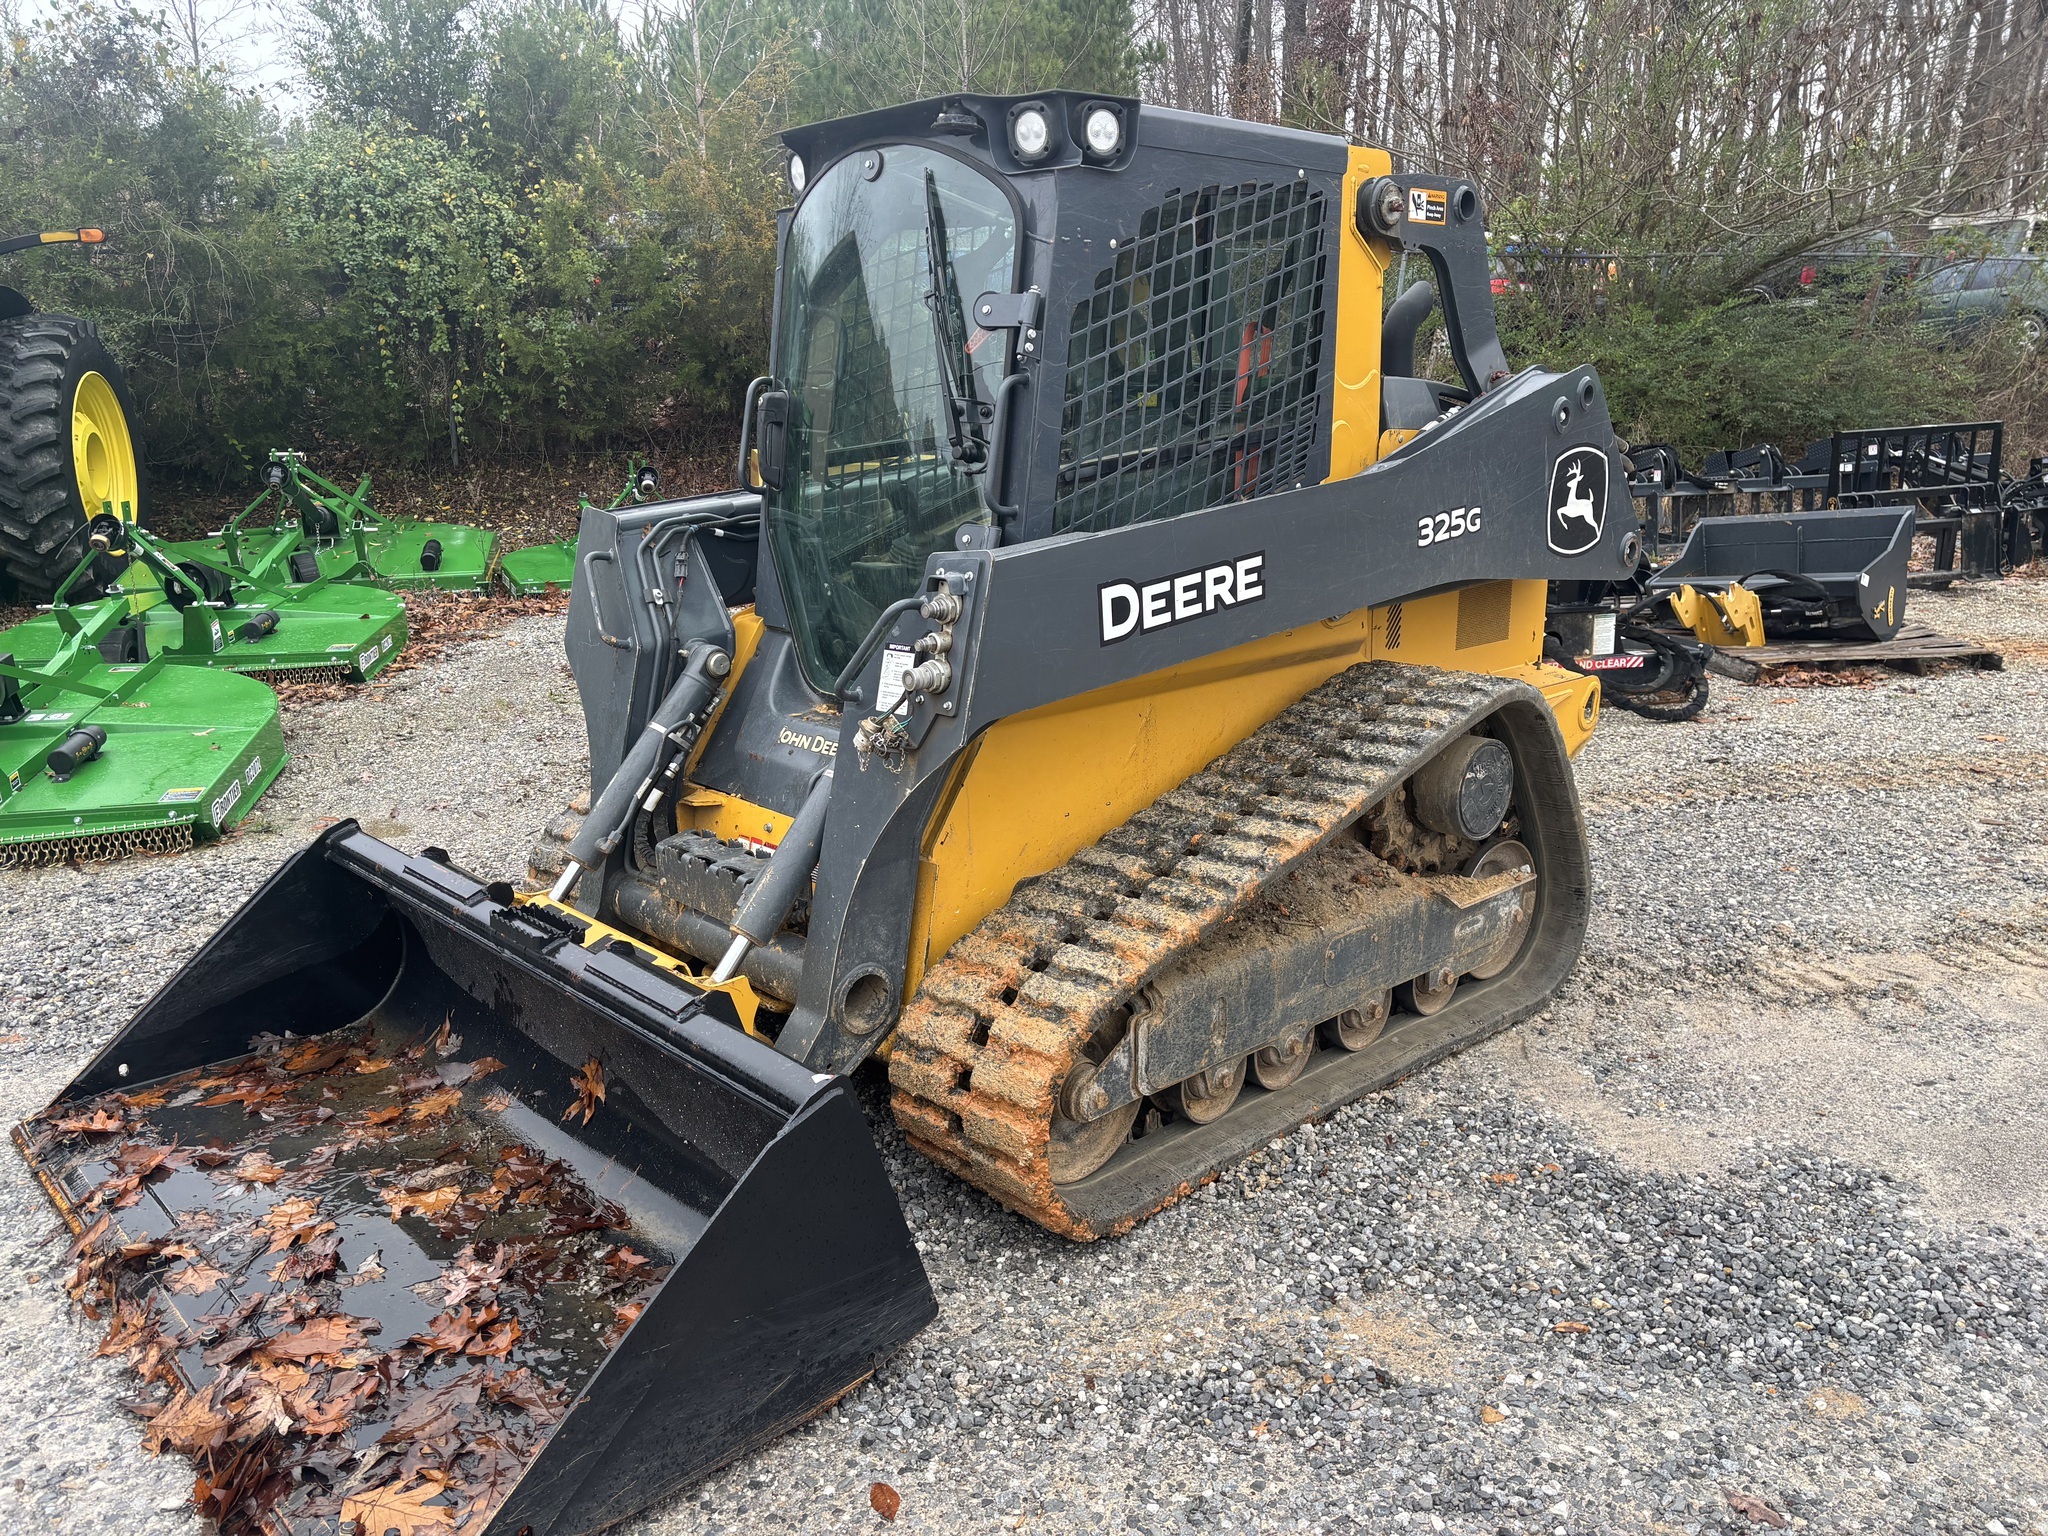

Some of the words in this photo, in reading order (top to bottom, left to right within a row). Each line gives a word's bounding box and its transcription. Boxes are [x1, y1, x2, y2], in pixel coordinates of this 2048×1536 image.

[1417, 507, 1481, 547] 325G
[1101, 555, 1263, 642] DEERE
[889, 643, 912, 652] IMPORTANT
[1595, 658, 1626, 669] CLEAR
[811, 735, 839, 757] DEE
[212, 780, 241, 826] FRONTIER
